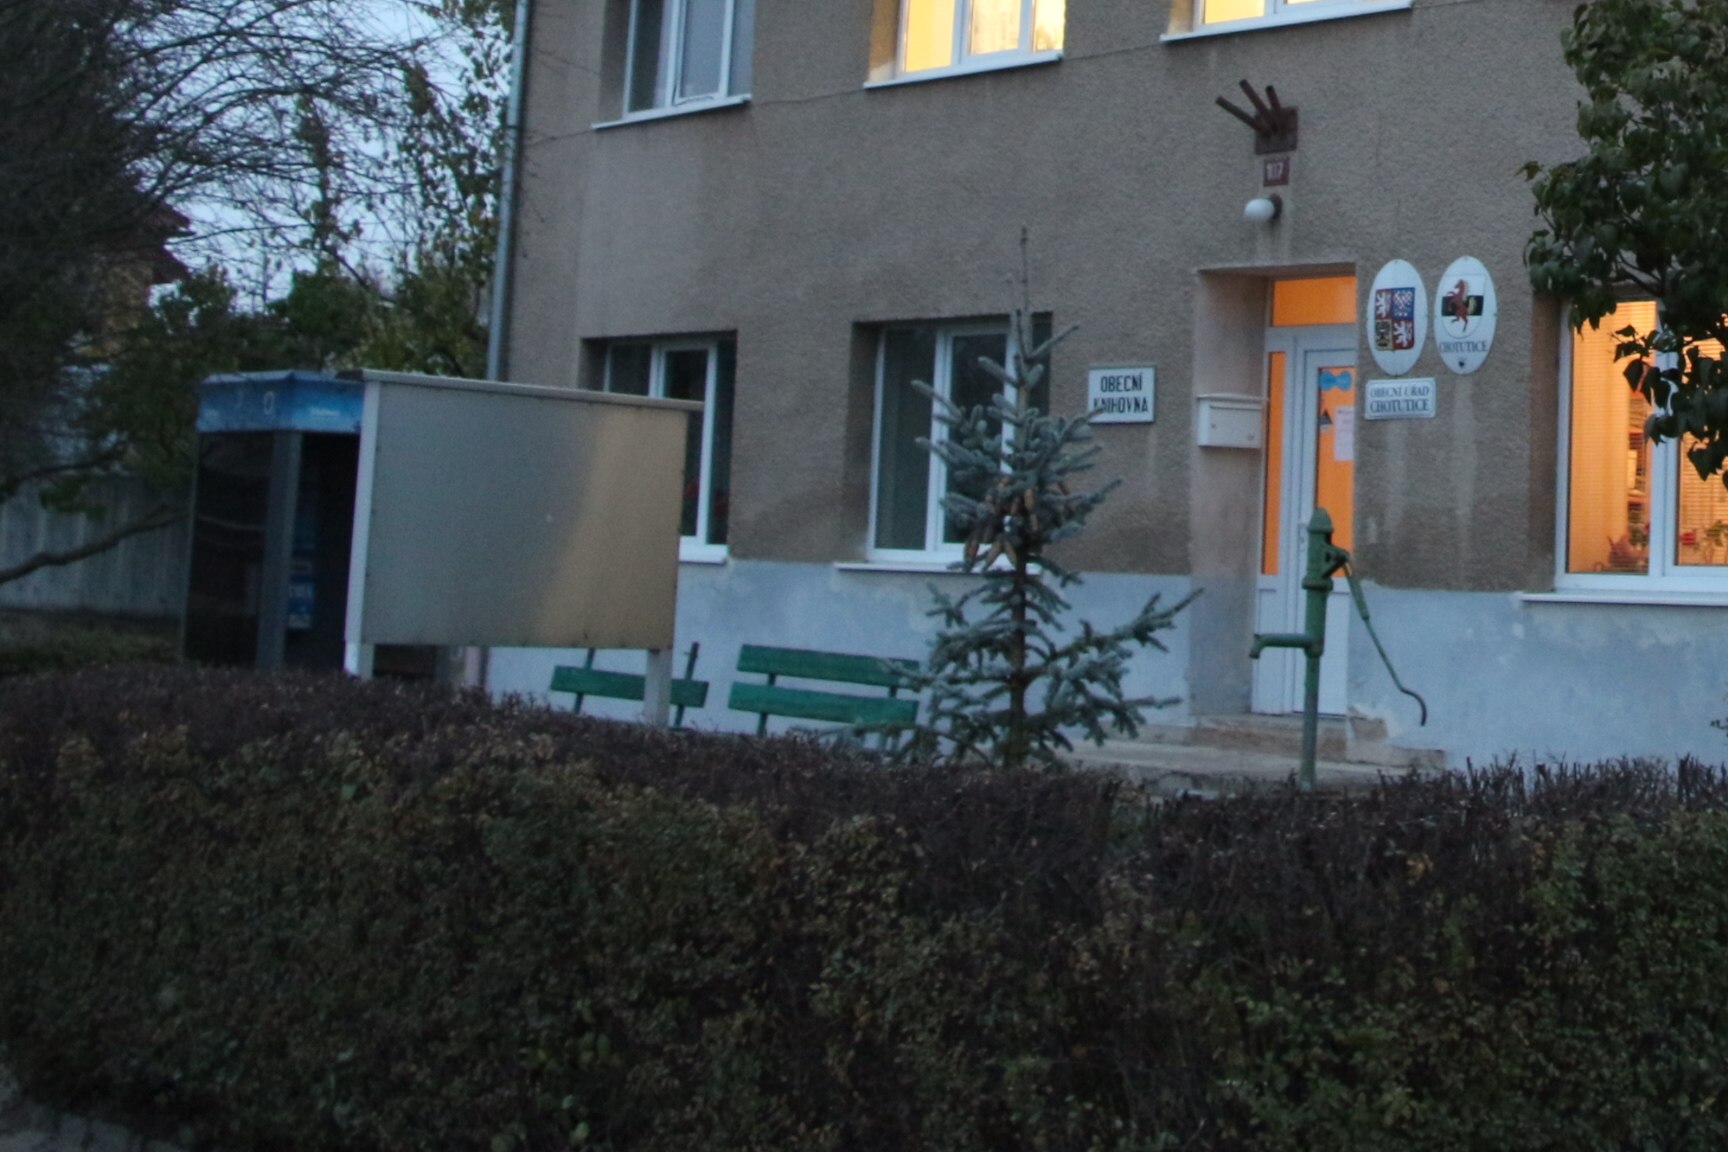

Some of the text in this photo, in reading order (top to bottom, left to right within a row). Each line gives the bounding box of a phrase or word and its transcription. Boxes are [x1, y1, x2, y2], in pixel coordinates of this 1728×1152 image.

[1440, 340, 1489, 353] CHOTUTICE
[1100, 372, 1143, 393] OBECNÍ
[1370, 398, 1430, 414] CHOTUTICE
